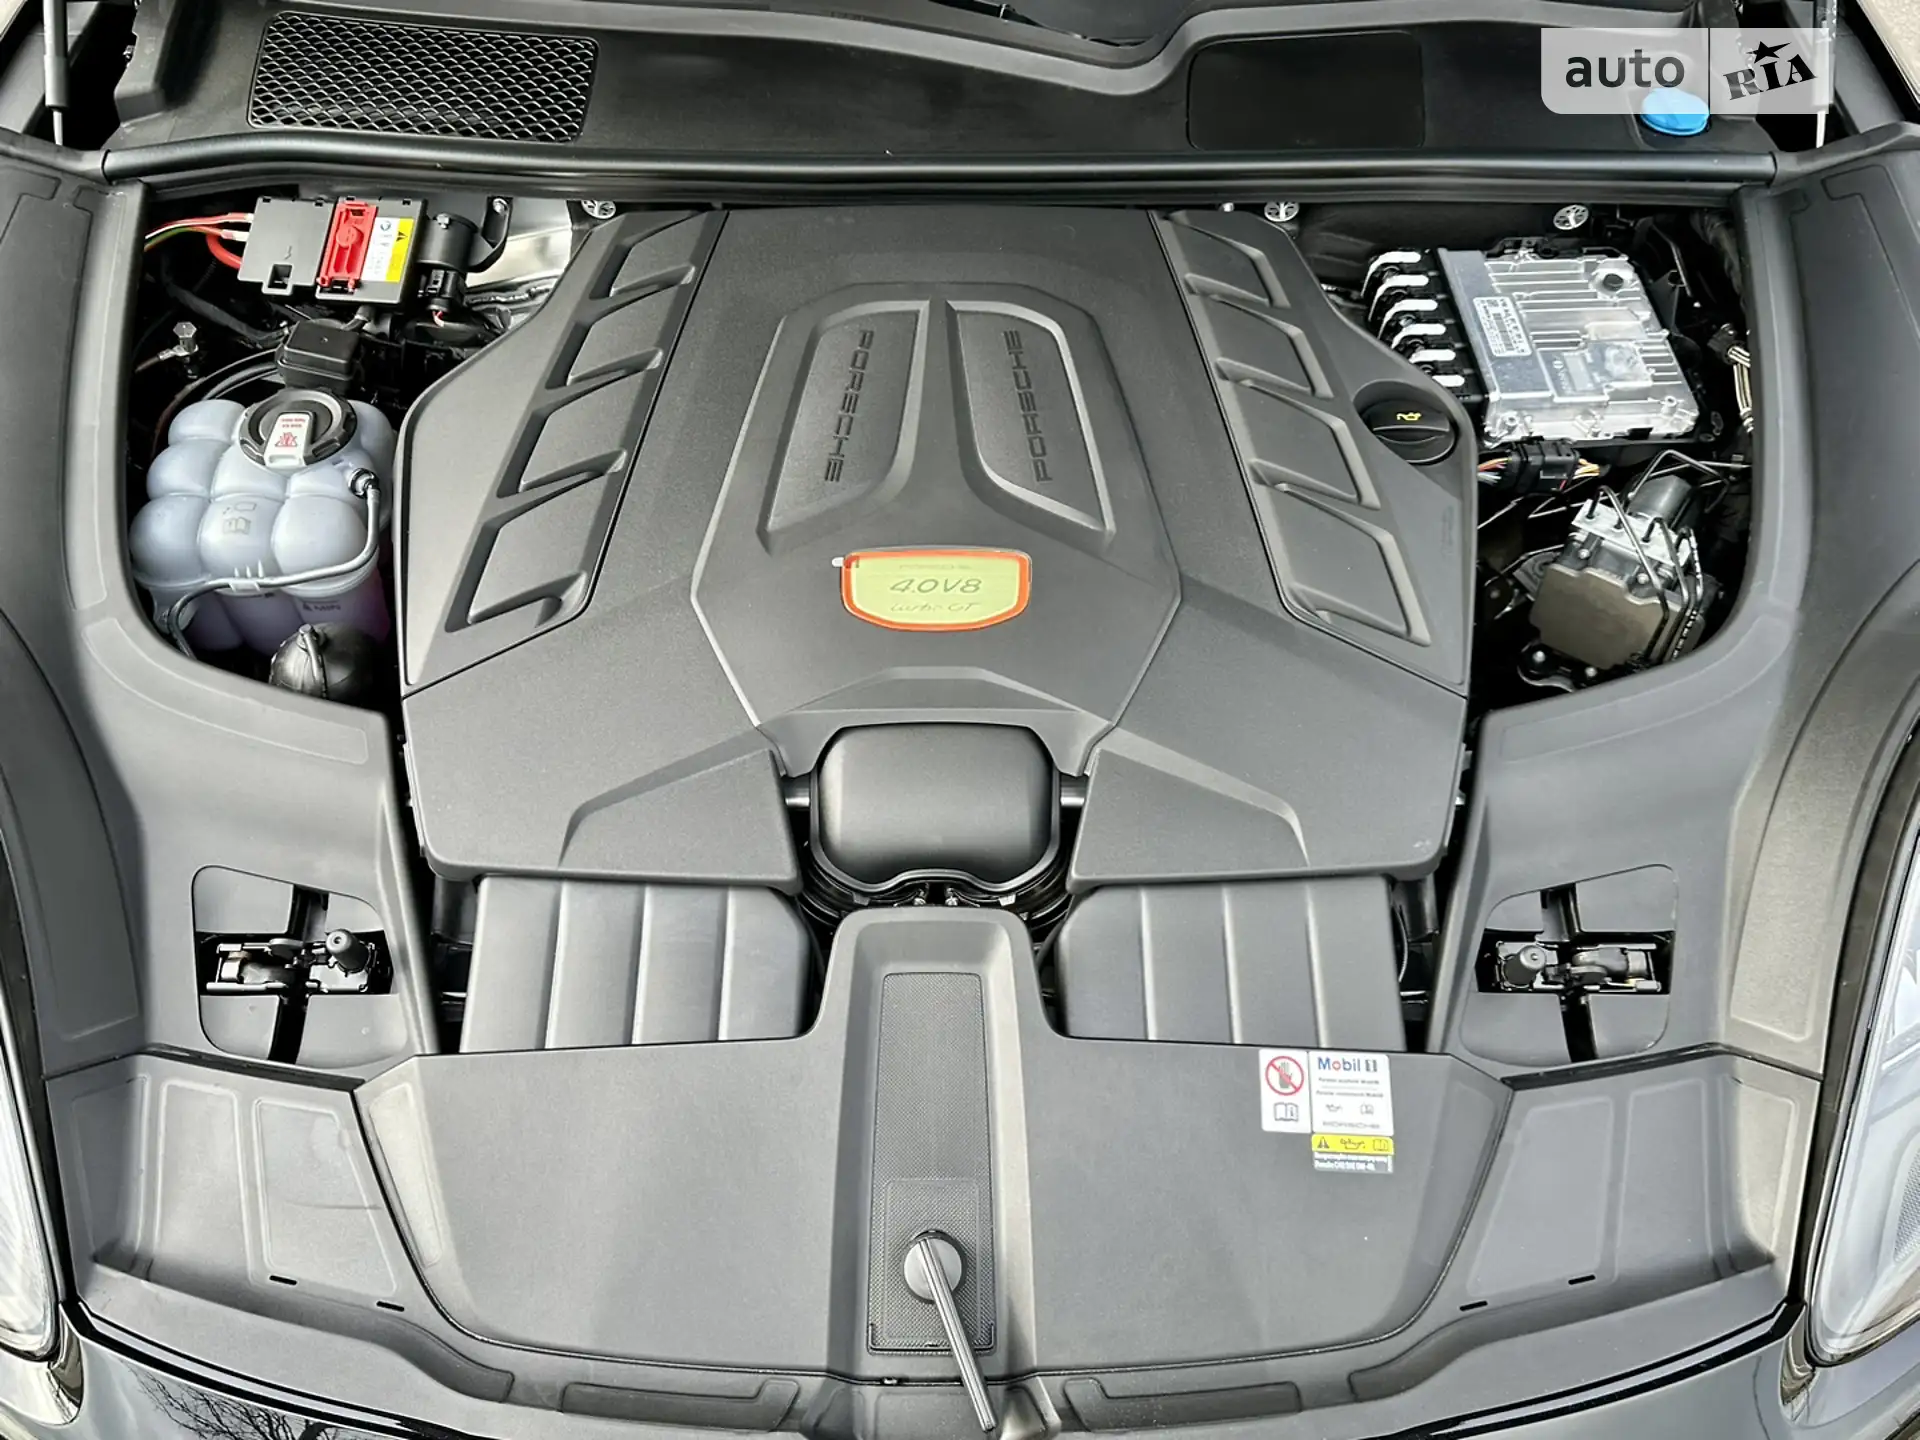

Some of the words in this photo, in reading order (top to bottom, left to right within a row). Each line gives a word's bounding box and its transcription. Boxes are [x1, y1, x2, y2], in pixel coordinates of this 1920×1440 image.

[823, 328, 875, 483] PORSCHE
[1003, 329, 1053, 483] PORSCHE
[947, 601, 981, 612] GT
[1317, 1056, 1361, 1072] Mobil
